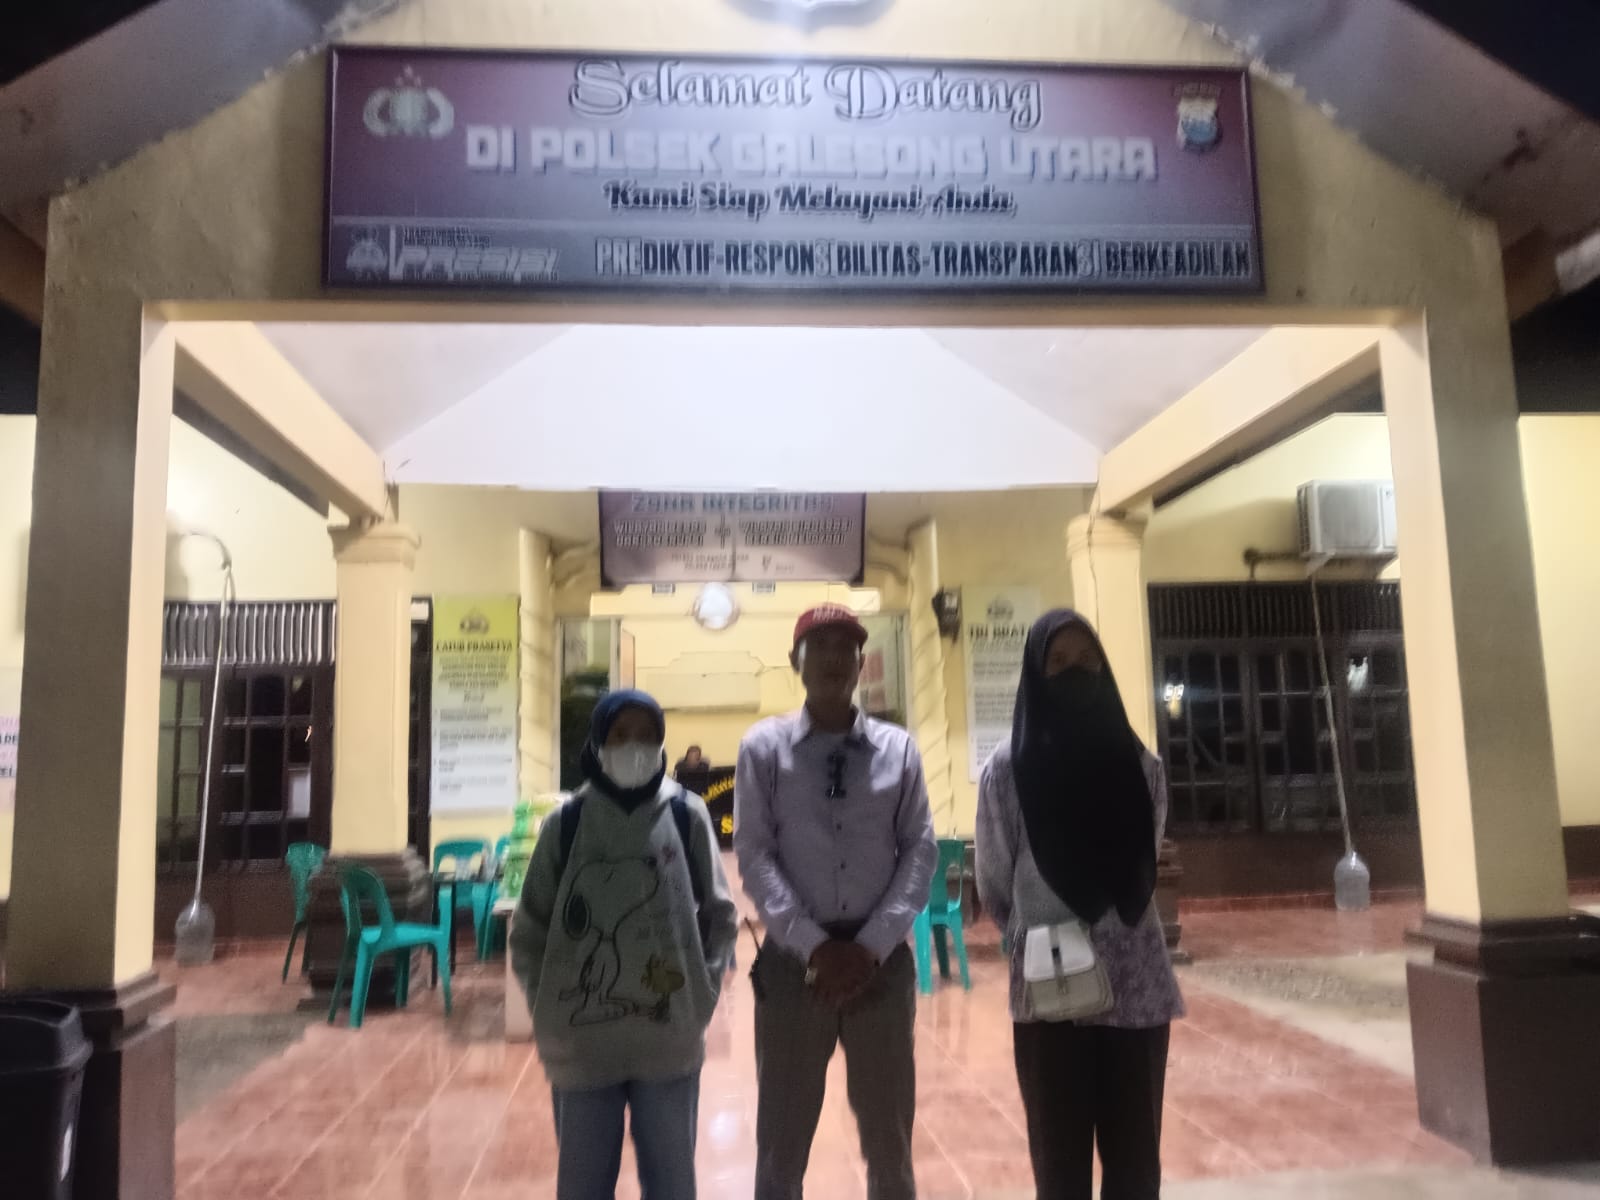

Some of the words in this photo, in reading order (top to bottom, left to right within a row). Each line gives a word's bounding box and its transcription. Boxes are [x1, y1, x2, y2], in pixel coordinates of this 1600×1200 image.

[569, 58, 811, 120] Selamat
[824, 63, 1043, 131] Datang
[466, 126, 516, 173] DI
[531, 128, 720, 174] POLSEK
[731, 131, 990, 179] GALESONG
[1002, 135, 1159, 181] UTARA
[603, 179, 695, 211] Kami
[700, 181, 769, 222] Siap
[775, 182, 922, 220] Melayani
[925, 184, 1017, 217] Anda
[1104, 239, 1250, 278] BERKEADILAN
